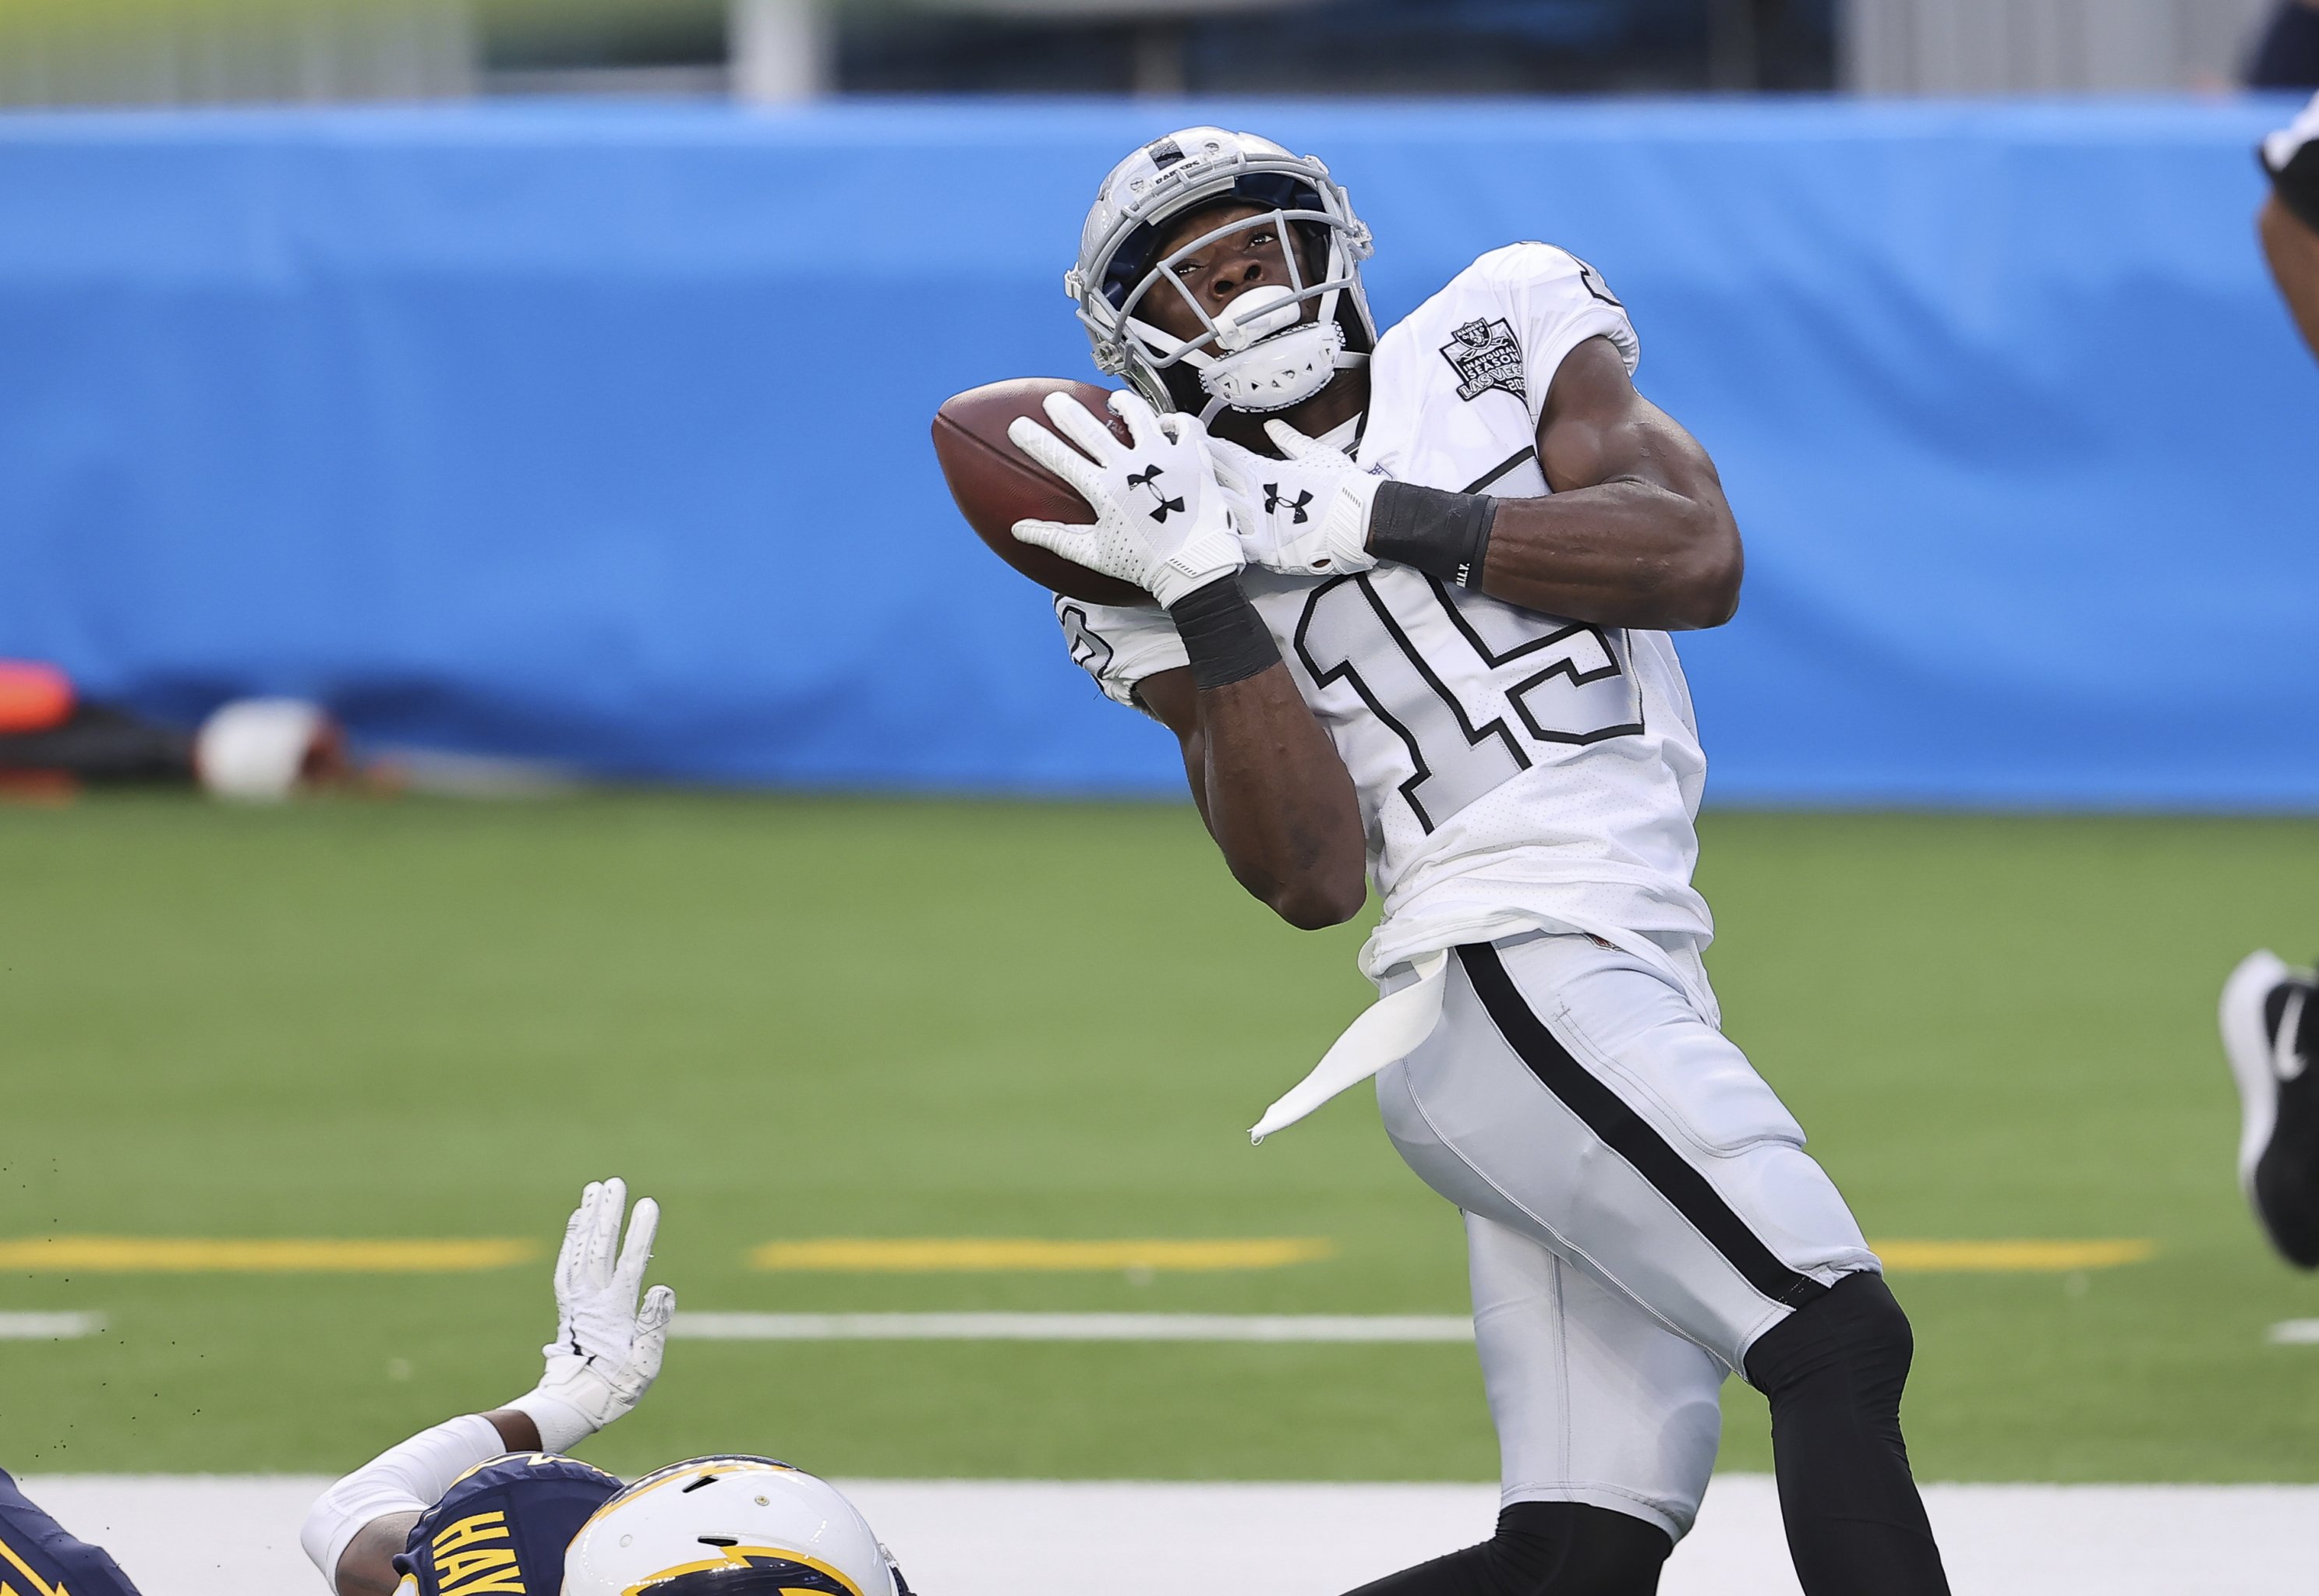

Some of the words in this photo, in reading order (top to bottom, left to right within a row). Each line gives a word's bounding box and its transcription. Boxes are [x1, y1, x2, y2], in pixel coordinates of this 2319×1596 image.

[1458, 373, 1494, 398] LAS
[1487, 363, 1523, 381] VEG
[1467, 352, 1520, 379] SEASON
[1294, 445, 1646, 836] 15
